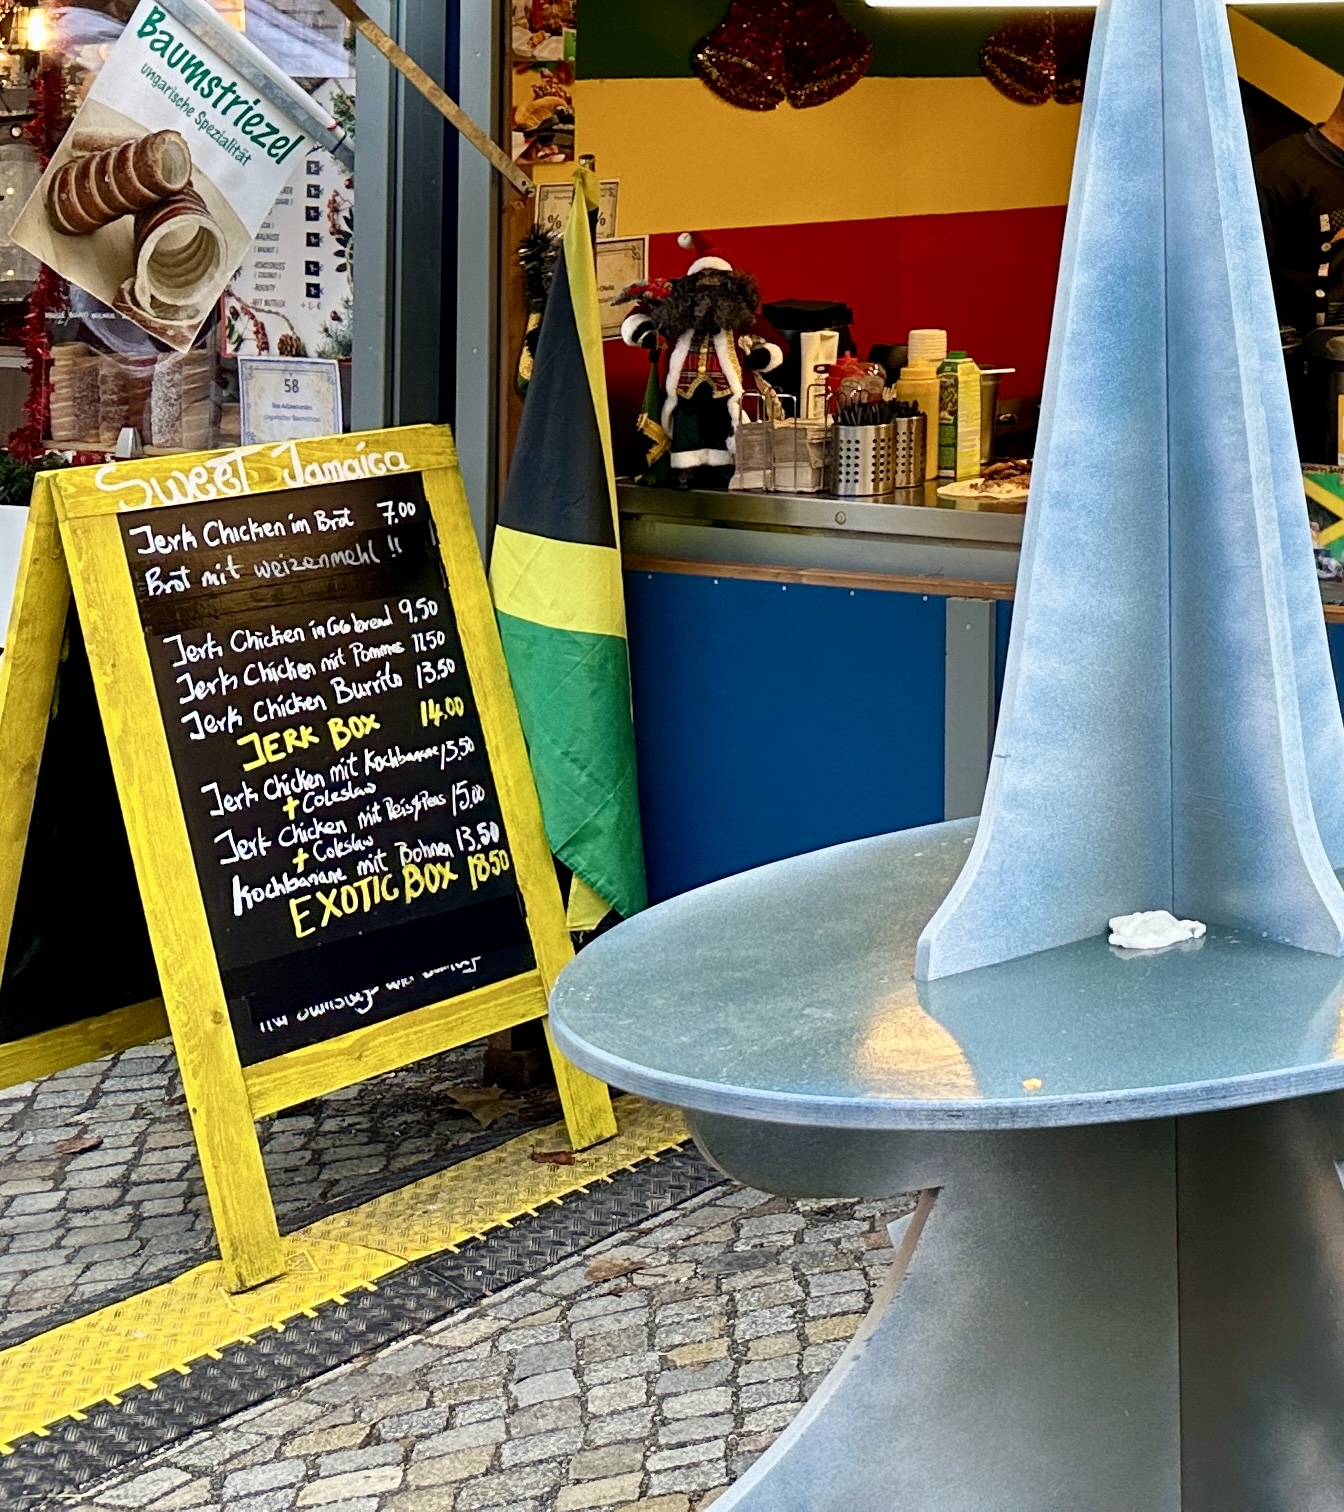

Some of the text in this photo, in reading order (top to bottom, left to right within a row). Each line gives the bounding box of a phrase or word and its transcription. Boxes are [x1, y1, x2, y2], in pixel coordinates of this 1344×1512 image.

[136, 5, 306, 165] Baumstriezel
[140, 62, 252, 167] ungarische Spezialität
[284, 378, 300, 393] 58
[271, 441, 411, 488] Jamaica
[129, 501, 416, 555] Jerk Chicken in Brot 7.00
[145, 566, 192, 596] Brot
[201, 555, 244, 587] mit
[163, 632, 223, 668] Jerk
[230, 625, 305, 653] Chicken
[399, 597, 439, 624] 9.50
[176, 668, 238, 704] Jerk
[244, 657, 316, 686] Chicken
[180, 657, 456, 740] Jerk Chicken Burrito 13.50
[236, 696, 464, 772] JERK BOX 14.00
[201, 782, 258, 817] Jerk
[263, 767, 325, 800] Chicken
[330, 756, 359, 783] mit
[213, 827, 272, 865] Jerk
[278, 818, 347, 849] Chicken
[357, 806, 383, 831] mit
[452, 780, 485, 817] 15.00
[357, 849, 389, 876] mit
[394, 839, 454, 867] Bohnen
[456, 821, 500, 852] 13.50
[289, 874, 399, 939] EXOTIC
[402, 861, 459, 904] BOX
